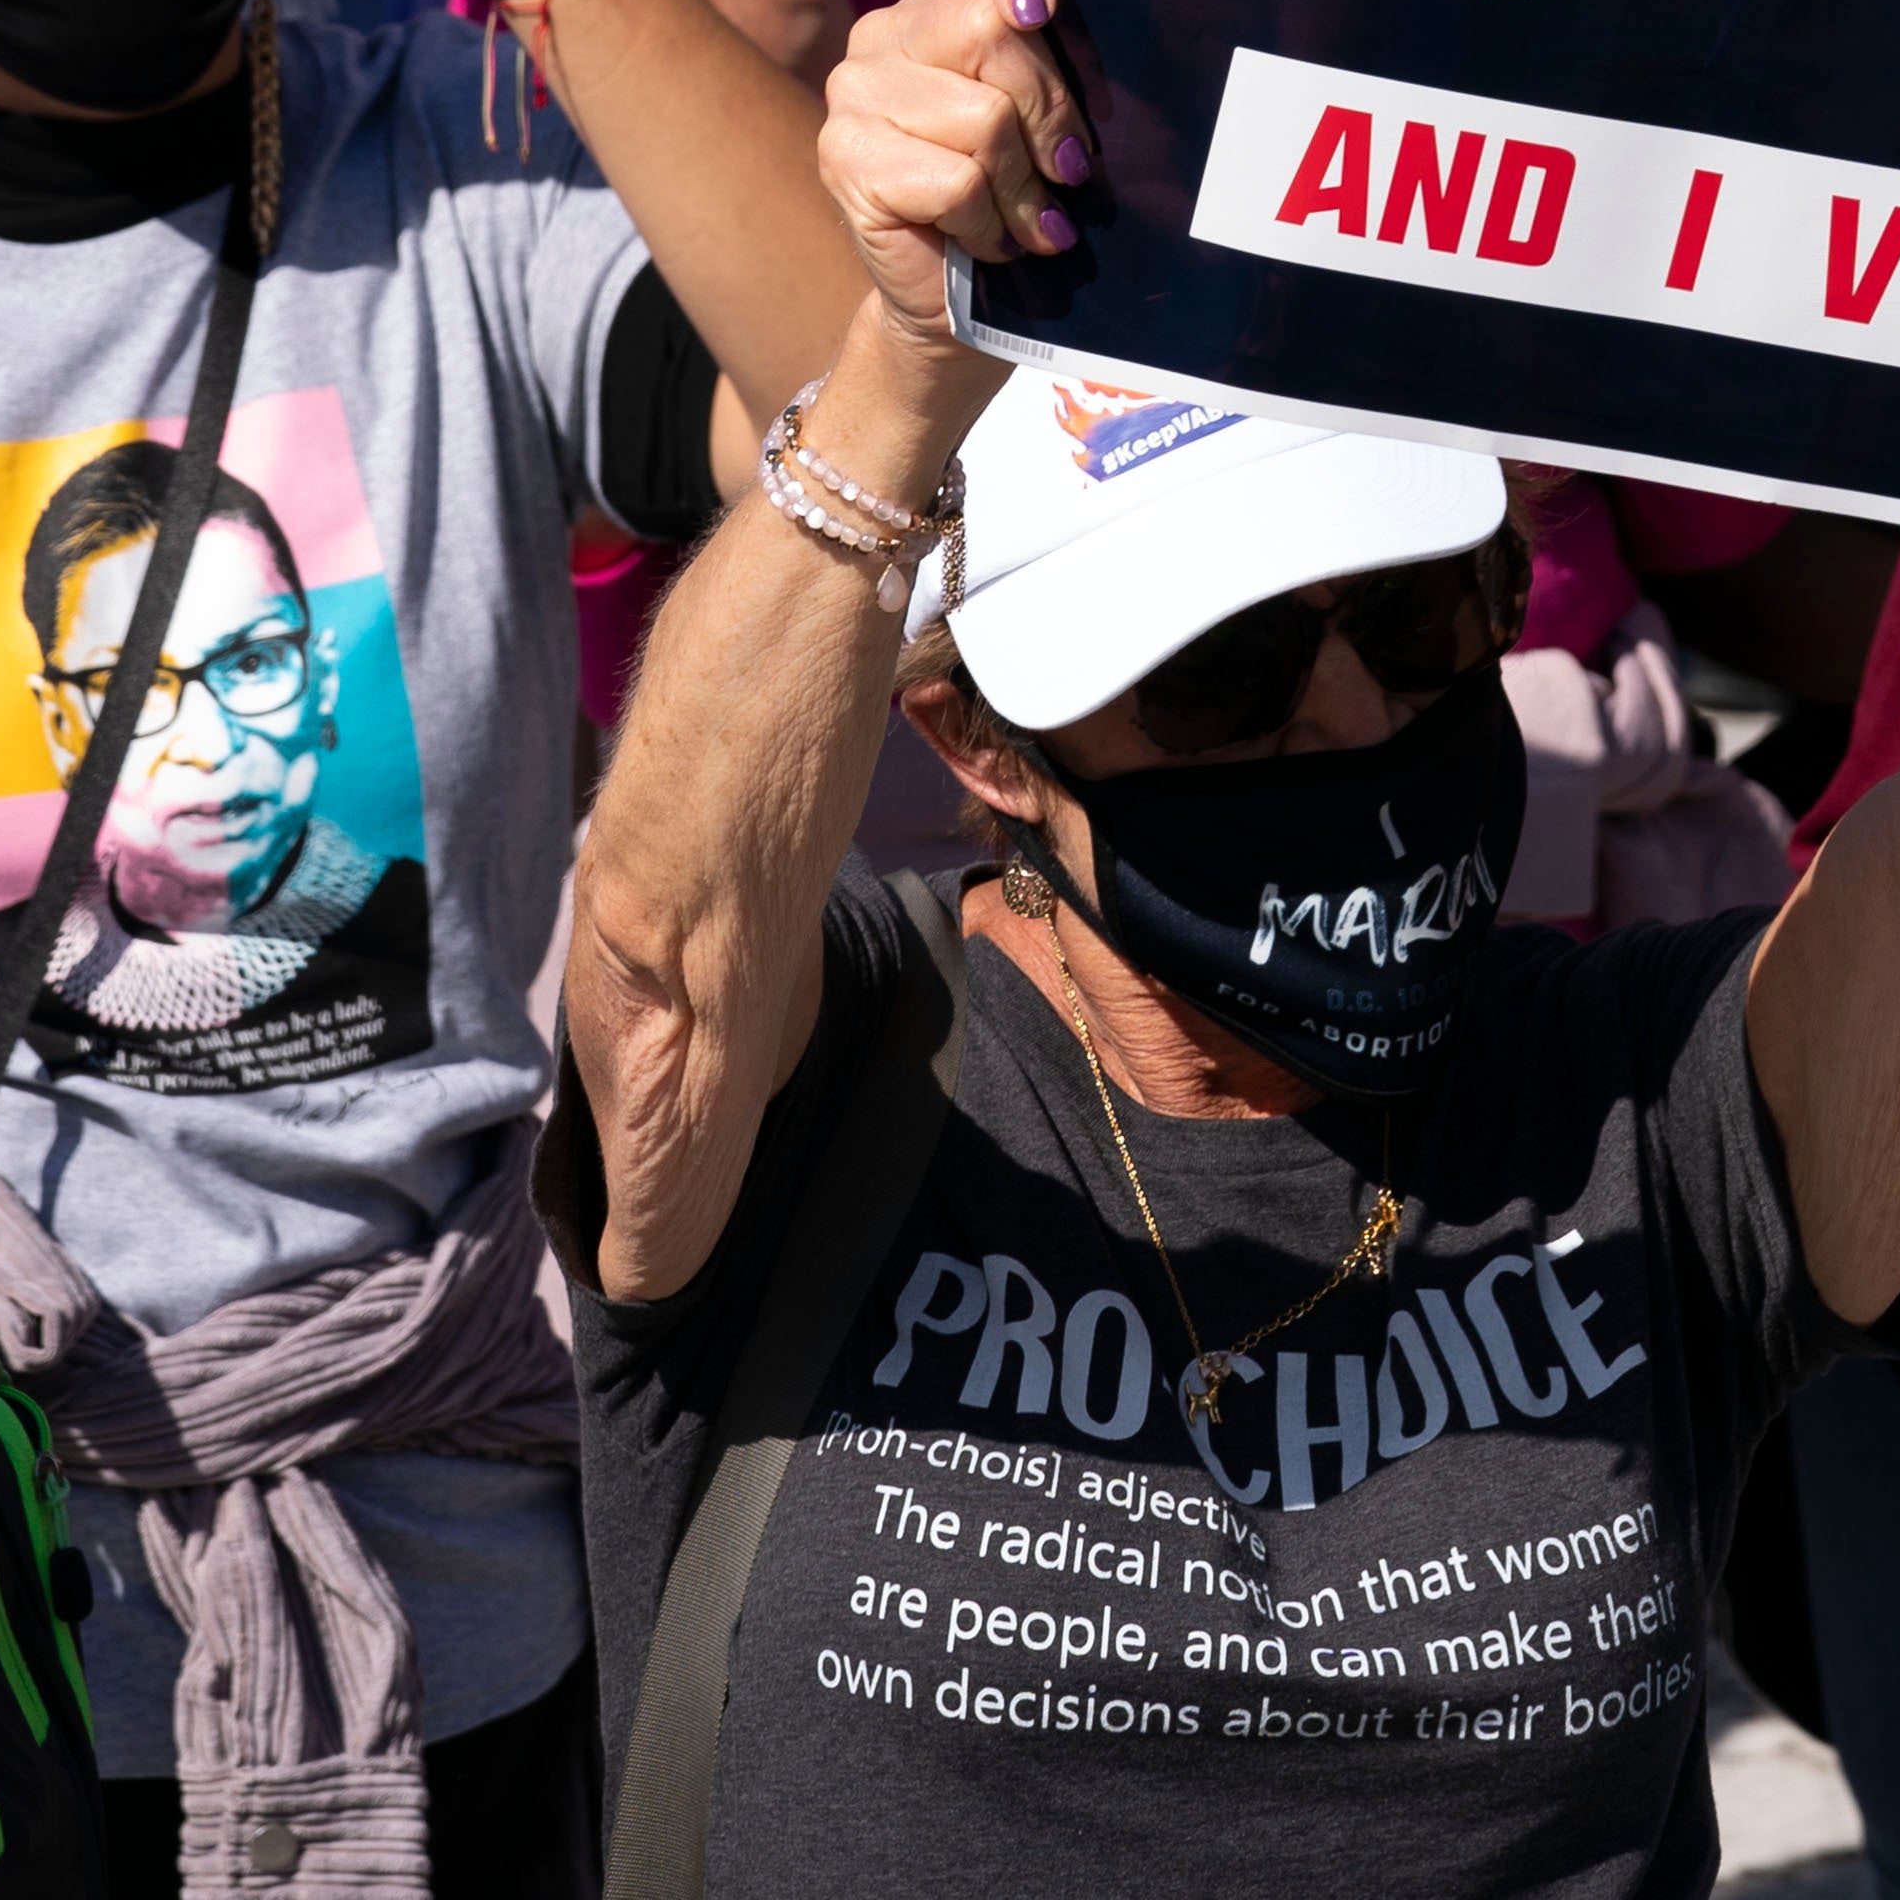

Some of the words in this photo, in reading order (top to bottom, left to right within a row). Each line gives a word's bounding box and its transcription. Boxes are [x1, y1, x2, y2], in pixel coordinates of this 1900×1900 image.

[1275, 104, 1577, 268] AND
[1665, 170, 1724, 292] I
[1101, 404, 1238, 475] #KeepVAB
[1379, 801, 1407, 860] I
[1217, 982, 1280, 1015] FOR
[872, 1251, 1153, 1441] PRO
[1178, 1229, 1649, 1512] CHOICE
[817, 1410, 1062, 1499] [Proh-chois]
[1078, 1470, 1267, 1561] adjective
[874, 1484, 961, 1550] The
[979, 1520, 1161, 1589] radical
[1184, 1557, 1345, 1630] notion
[1358, 1546, 1476, 1615] that
[1485, 1502, 1661, 1585] women
[850, 1574, 928, 1629] are
[946, 1598, 1160, 1671] people,
[1184, 1627, 1288, 1677] and
[1310, 1645, 1408, 1679] can
[1424, 1610, 1573, 1676] make
[1588, 1573, 1679, 1654] their
[817, 1648, 914, 1708] own
[935, 1666, 1201, 1735] decisions
[1221, 1695, 1391, 1742] about
[1413, 1692, 1544, 1742] their
